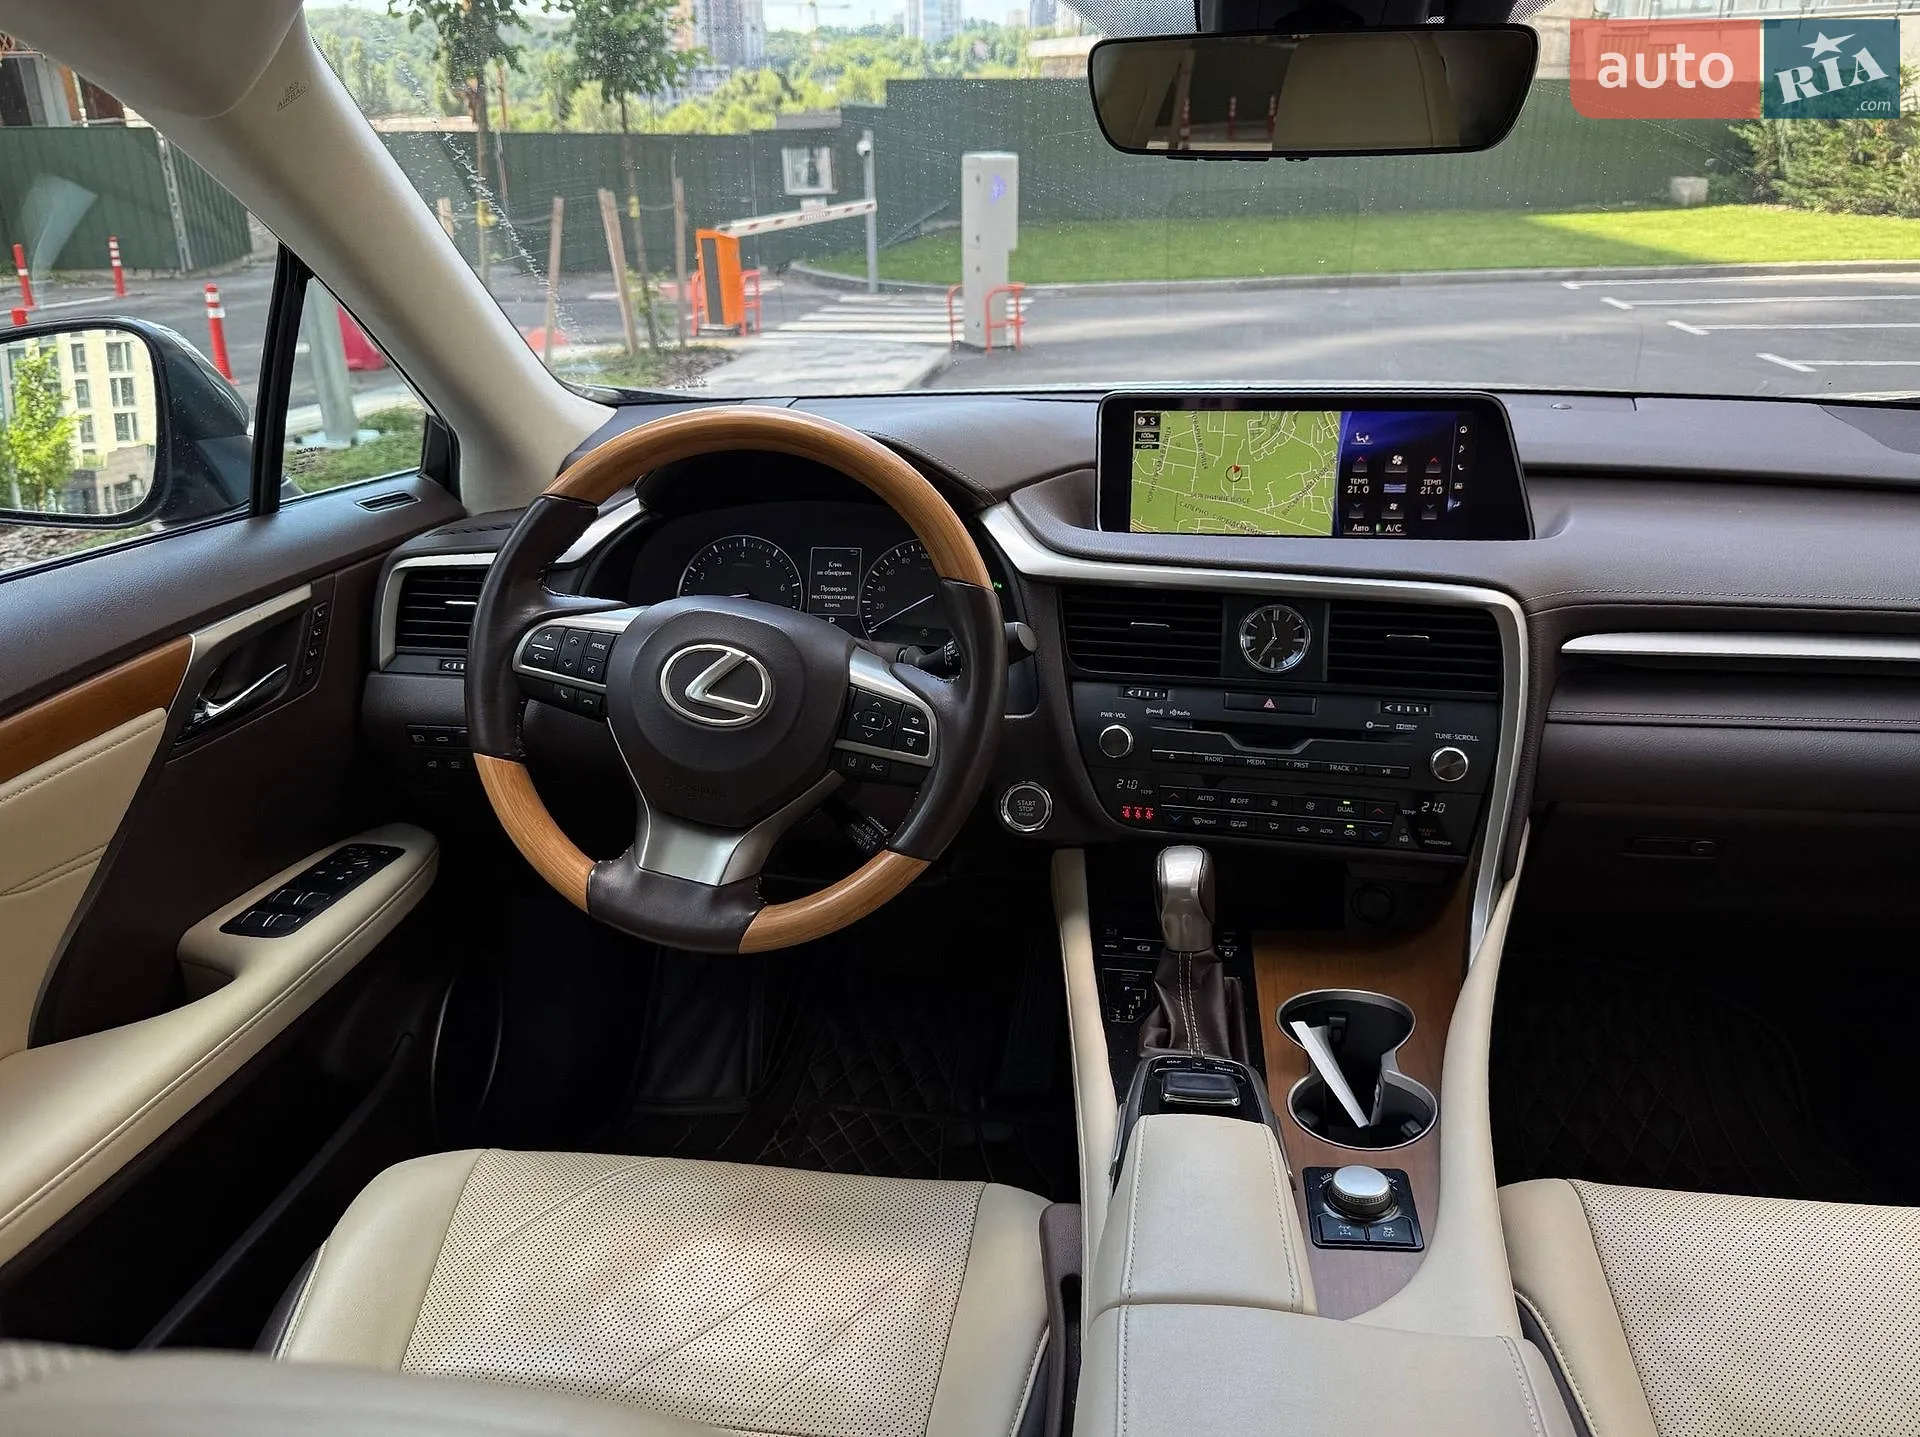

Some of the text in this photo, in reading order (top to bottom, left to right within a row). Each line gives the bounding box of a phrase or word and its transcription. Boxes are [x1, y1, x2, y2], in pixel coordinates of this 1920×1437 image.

[1149, 417, 1156, 426] S
[1352, 523, 1370, 532] Авто
[1385, 524, 1402, 532] A/C
[1204, 755, 1224, 763] RADIO
[1246, 758, 1266, 766] MEDIA
